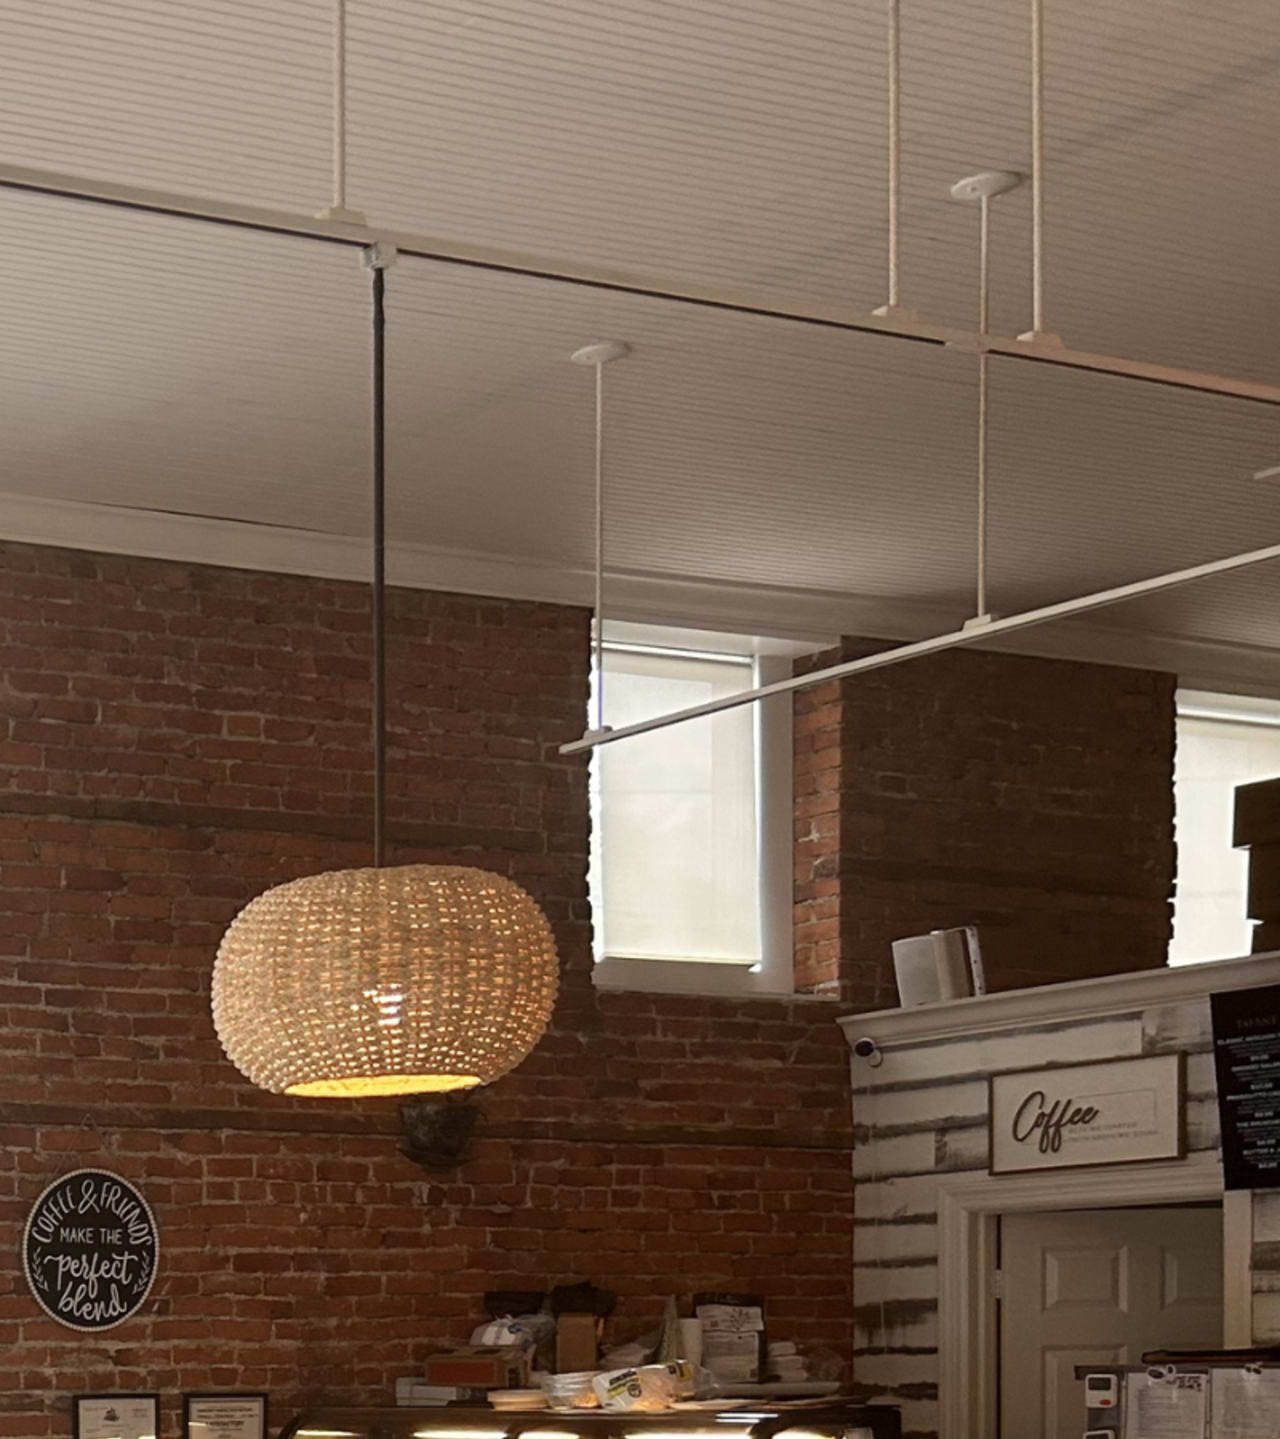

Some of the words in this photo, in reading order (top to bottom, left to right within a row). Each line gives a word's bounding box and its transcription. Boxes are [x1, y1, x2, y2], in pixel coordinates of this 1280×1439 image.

[1012, 1090, 1100, 1154] Coffee
[32, 1185, 77, 1243] COFFEE
[77, 1179, 100, 1214] &
[100, 1182, 153, 1246] FRIENDS
[59, 1227, 95, 1244] MAKE
[100, 1228, 123, 1245] THE
[43, 1251, 138, 1298] perfect
[58, 1282, 128, 1322] blend
